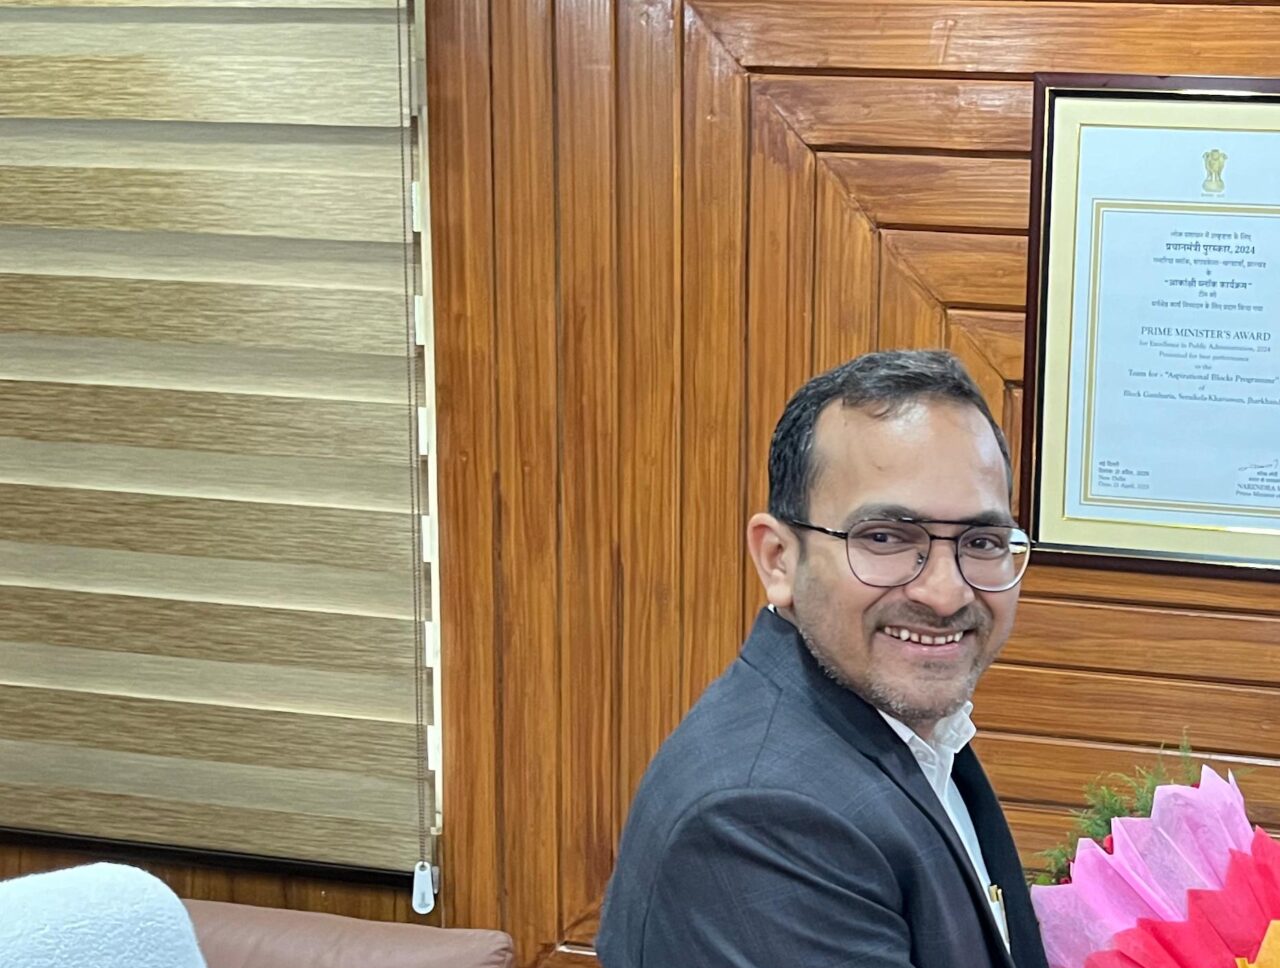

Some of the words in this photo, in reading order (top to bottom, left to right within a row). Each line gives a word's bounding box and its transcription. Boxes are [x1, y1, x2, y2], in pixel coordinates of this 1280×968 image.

[1235, 246, 1255, 254] 2024
[1141, 326, 1173, 336] PRIME
[1175, 328, 1231, 339] MINISTER'S
[1233, 331, 1271, 341] AWARD
